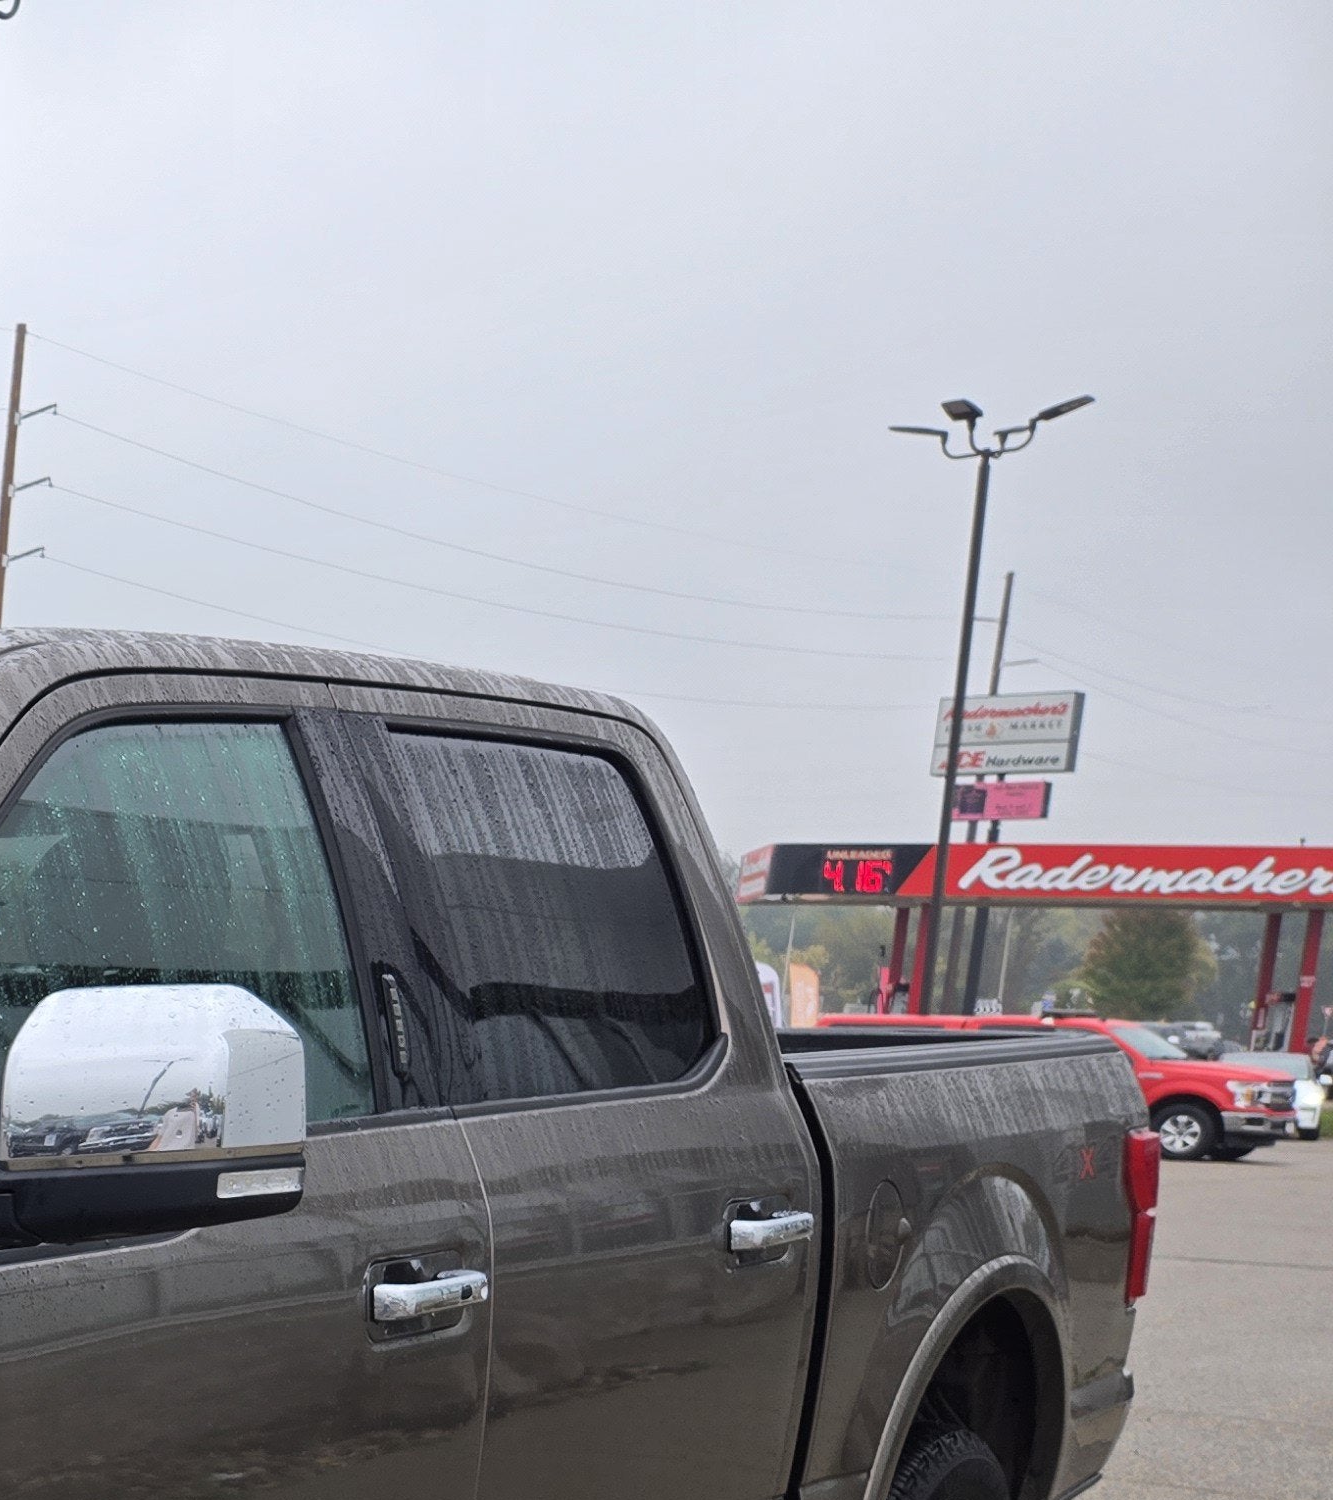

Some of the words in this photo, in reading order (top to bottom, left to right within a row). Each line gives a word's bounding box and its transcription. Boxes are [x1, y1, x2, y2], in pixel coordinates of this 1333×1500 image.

[1010, 720, 1064, 731] MARKET
[937, 750, 986, 770] CE
[985, 754, 1060, 768] Hardware
